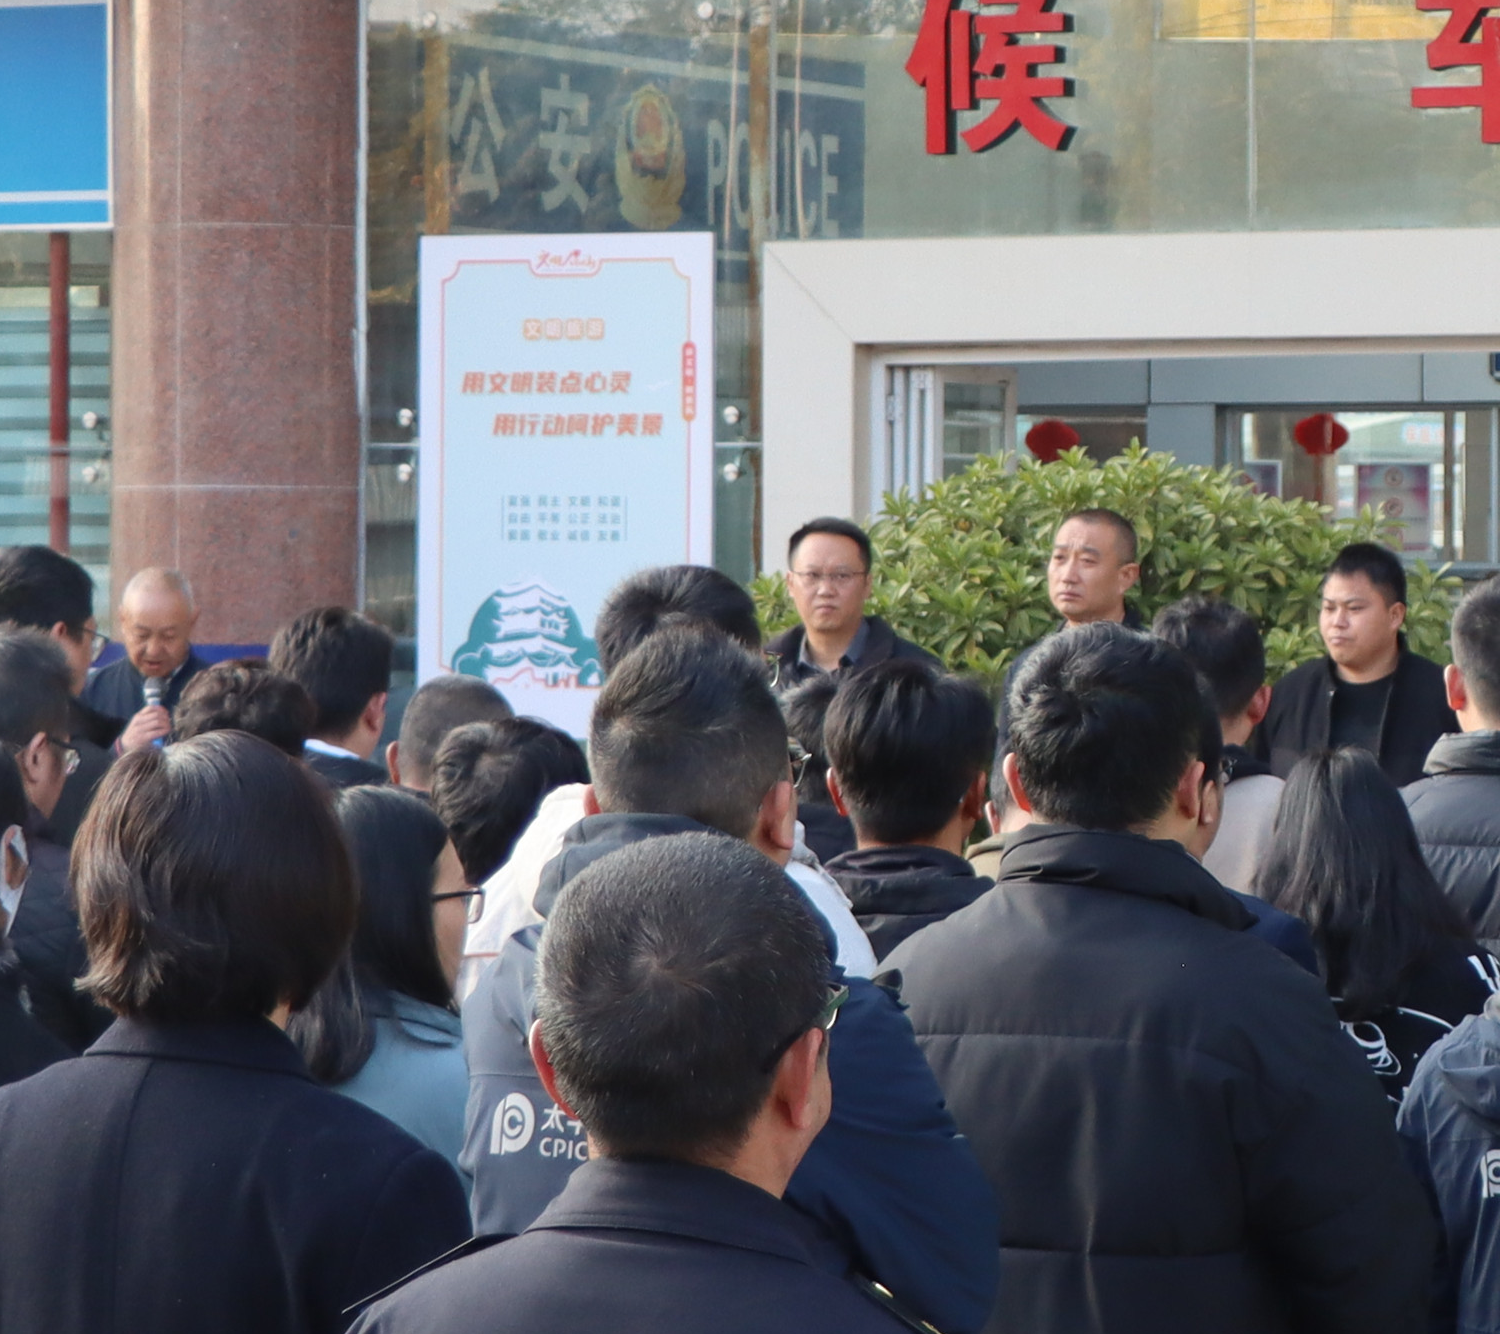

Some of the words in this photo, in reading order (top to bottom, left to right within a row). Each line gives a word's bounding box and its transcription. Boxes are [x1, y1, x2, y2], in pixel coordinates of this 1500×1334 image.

[448, 65, 594, 214] 公安
[461, 370, 632, 395] 用文明装点心灵
[539, 1136, 588, 1162] CPIC
